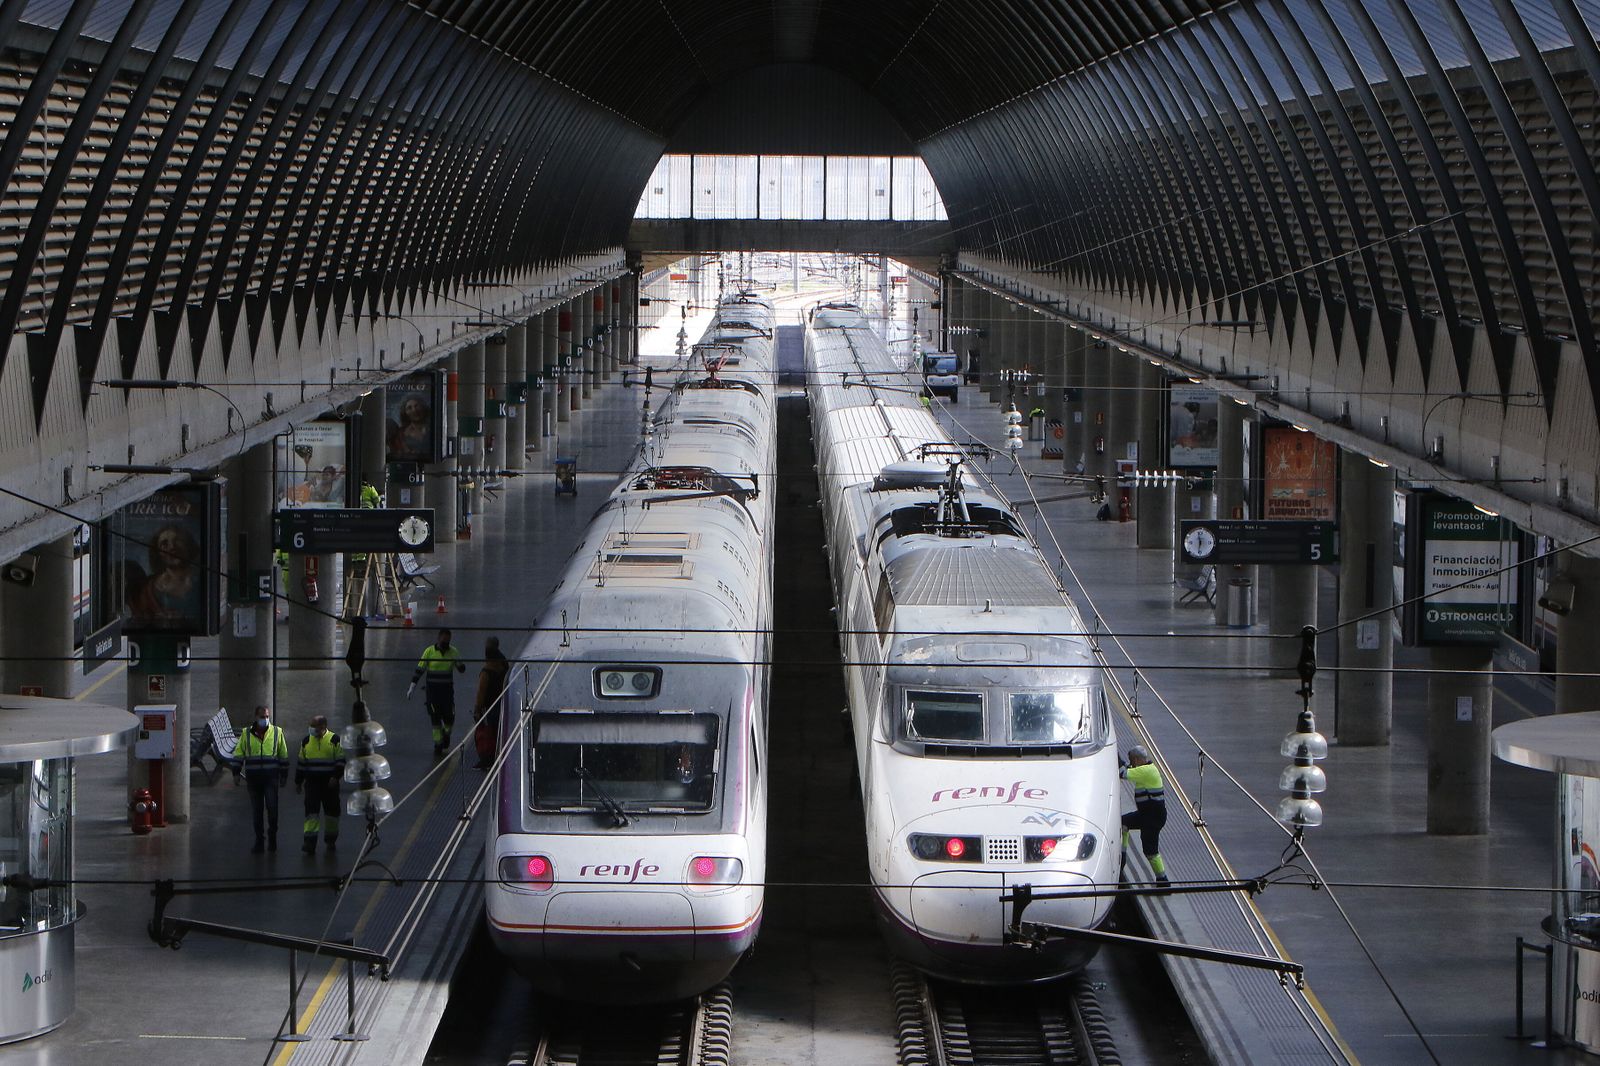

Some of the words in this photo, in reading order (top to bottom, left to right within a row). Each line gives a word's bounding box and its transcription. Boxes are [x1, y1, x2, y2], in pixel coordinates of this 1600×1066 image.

[578, 347, 583, 356] P
[499, 404, 506, 416] K
[477, 420, 483, 433] J
[408, 473, 416, 483] 6
[1269, 499, 1312, 508] FUTUROS
[1433, 522, 1484, 531] levantaos!
[293, 531, 304, 548] 6
[1310, 543, 1321, 560] 5
[259, 575, 271, 598] E
[127, 641, 140, 667] D
[177, 641, 190, 667] D
[932, 780, 1049, 804] renfe
[1020, 811, 1082, 828] AVE
[579, 857, 660, 884] renfe
